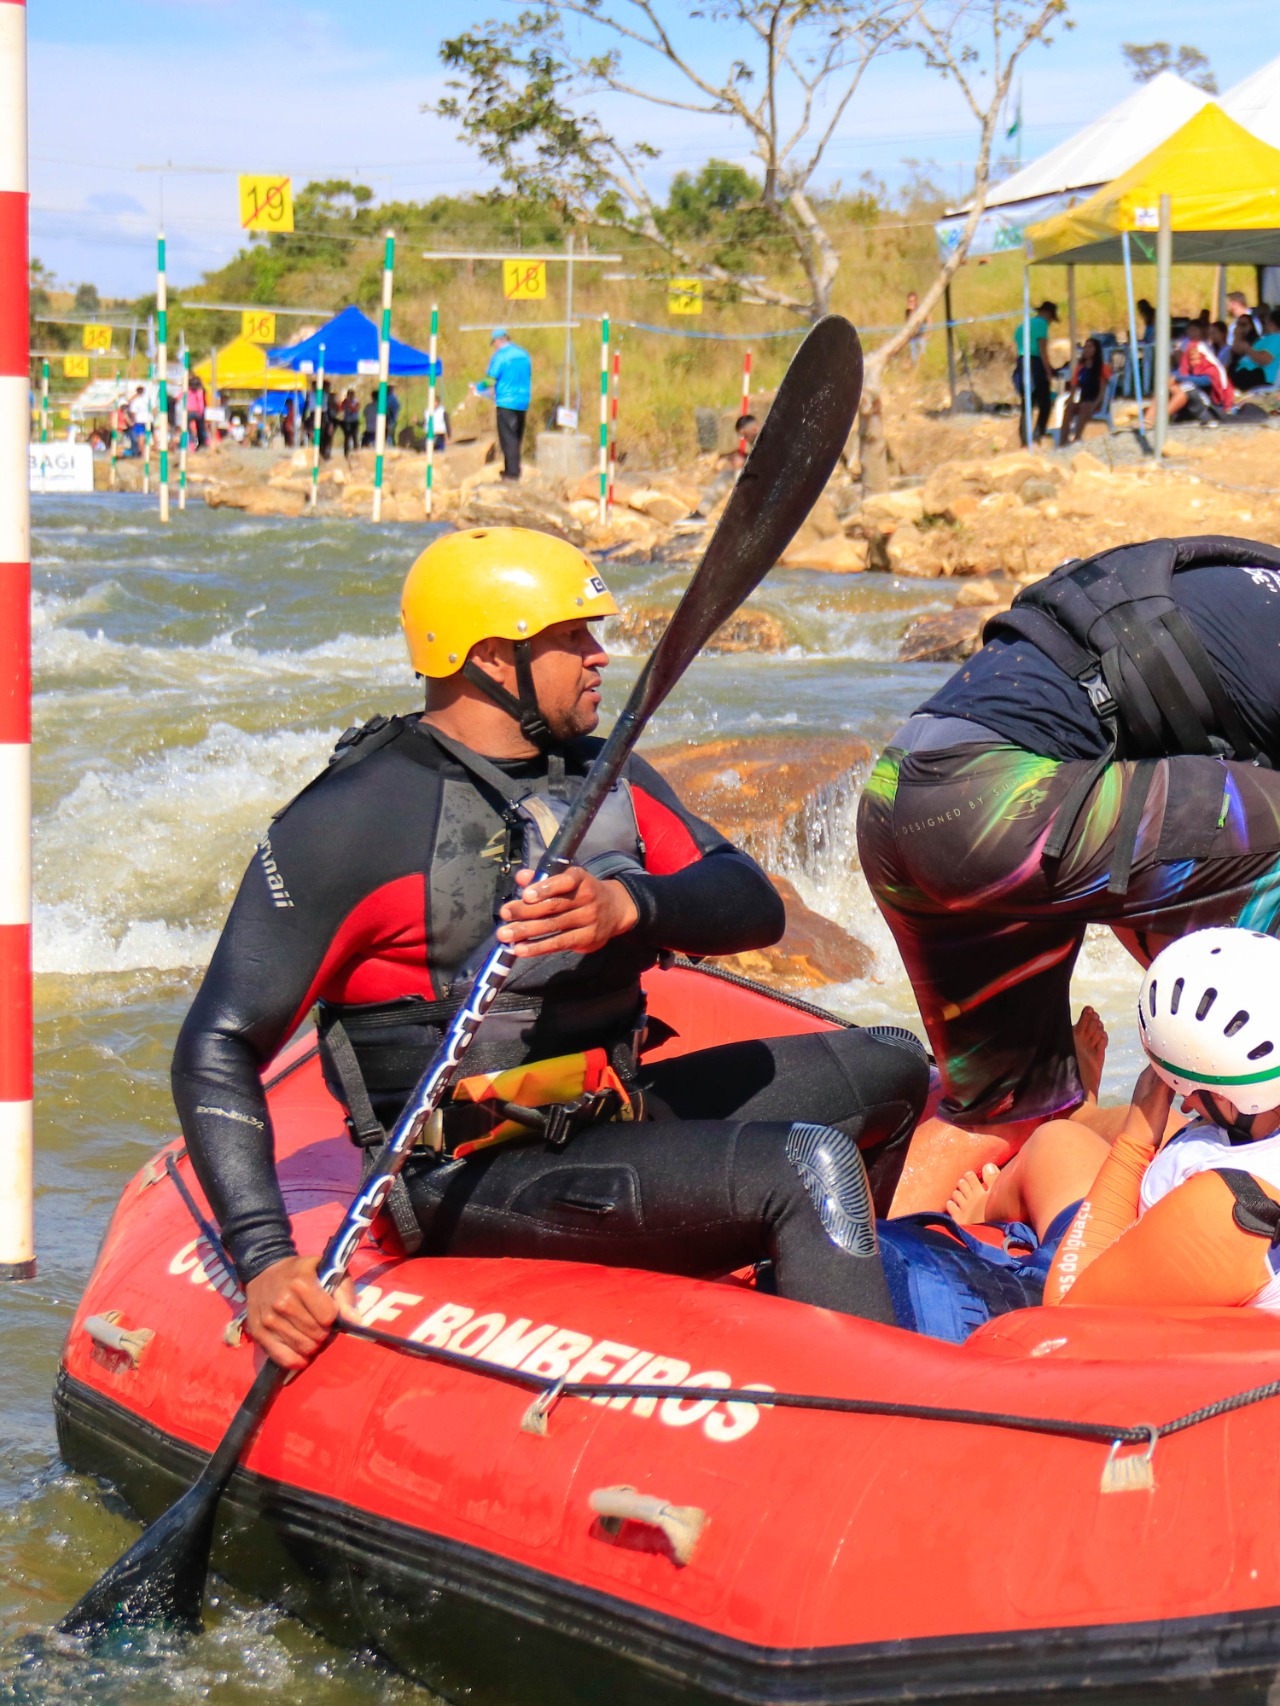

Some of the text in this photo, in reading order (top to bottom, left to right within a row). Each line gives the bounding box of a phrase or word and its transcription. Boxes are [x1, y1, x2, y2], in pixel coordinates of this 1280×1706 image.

[246, 186, 285, 222] 19
[510, 267, 540, 293] 18
[88, 329, 109, 347] 15
[248, 317, 272, 338] 16
[902, 808, 961, 835] DESIGNED
[968, 796, 984, 810] BY
[1062, 1201, 1093, 1251] Iguaçu
[1057, 1252, 1079, 1273] do
[405, 1301, 777, 1443] BOMBEIROS
